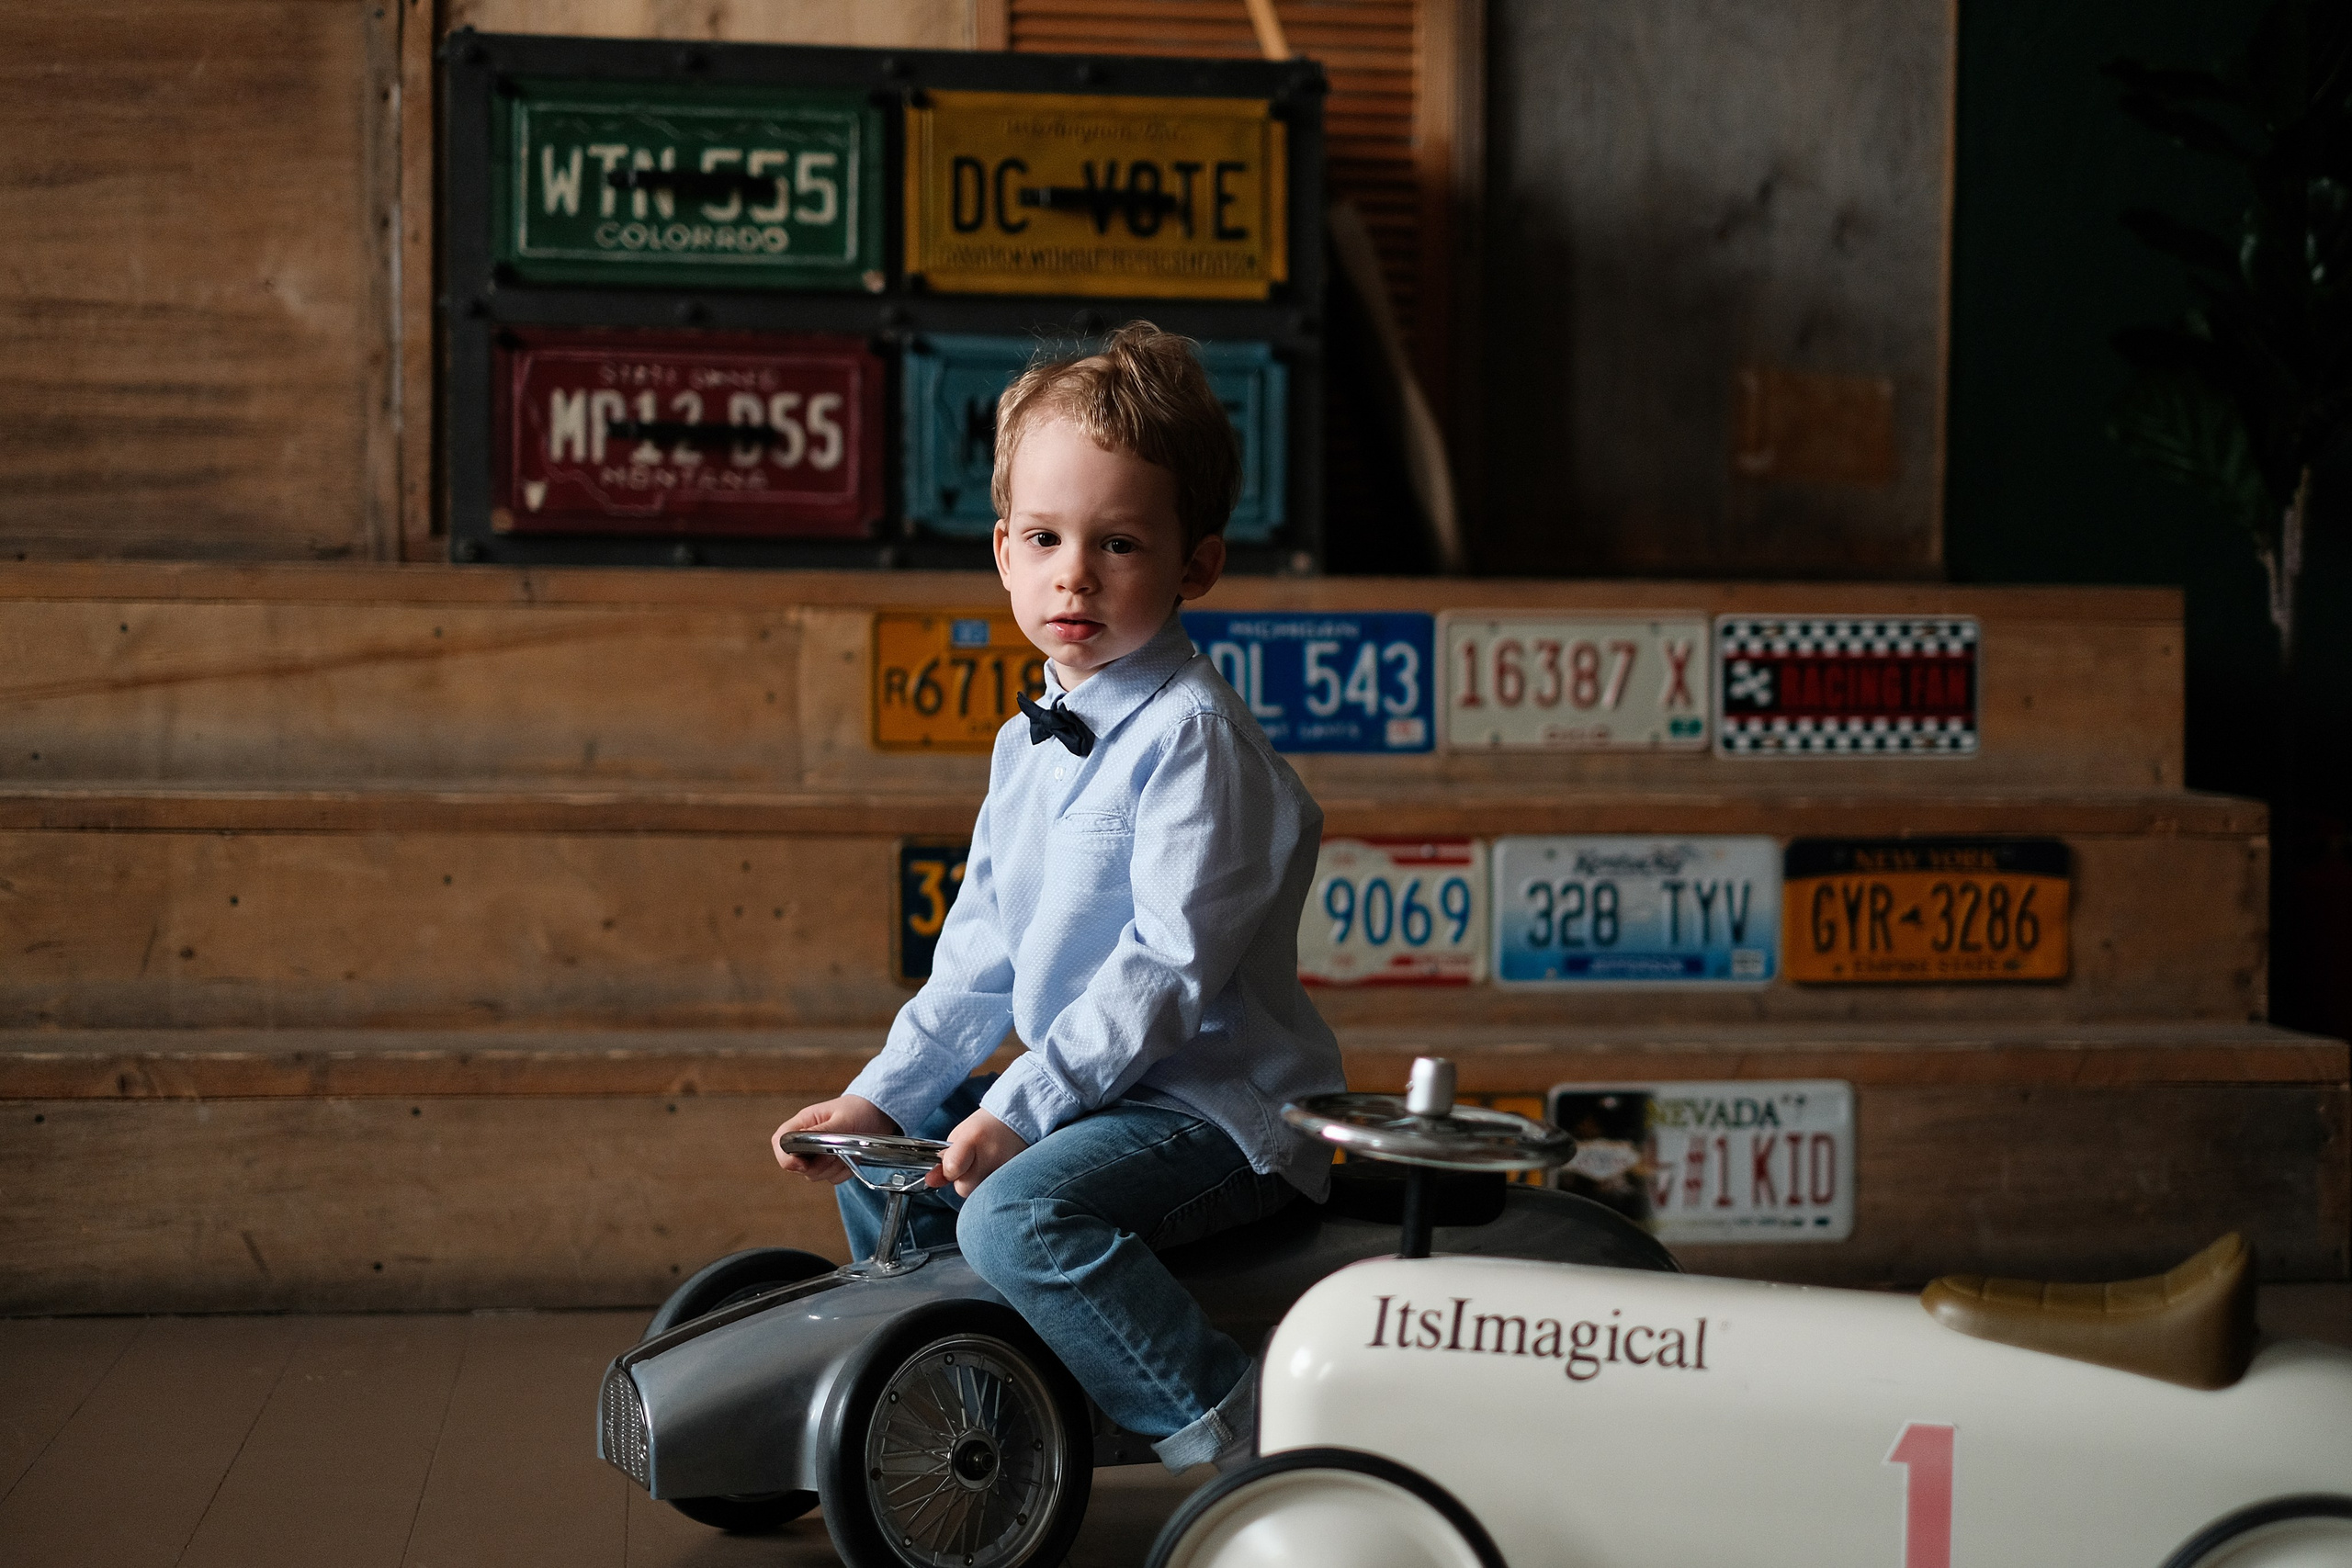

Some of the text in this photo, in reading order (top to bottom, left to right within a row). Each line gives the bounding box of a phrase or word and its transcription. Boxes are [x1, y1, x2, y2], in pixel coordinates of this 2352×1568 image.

[700, 146, 838, 225] 555
[953, 156, 1250, 242] DC VOTE
[593, 220, 791, 254] COLORADO
[1304, 640, 1420, 717] 543
[1458, 637, 1693, 710] 16387 X
[1781, 665, 1967, 707] RACING FAN
[909, 860, 967, 938] 3
[1323, 876, 1472, 947] 9069
[1527, 879, 1751, 949] 328 TYV
[1930, 882, 2041, 953] 3286
[1749, 1133, 1837, 1208] KID
[1366, 1294, 1710, 1380] ItsImagical
[1883, 1422, 1954, 1567] 1
